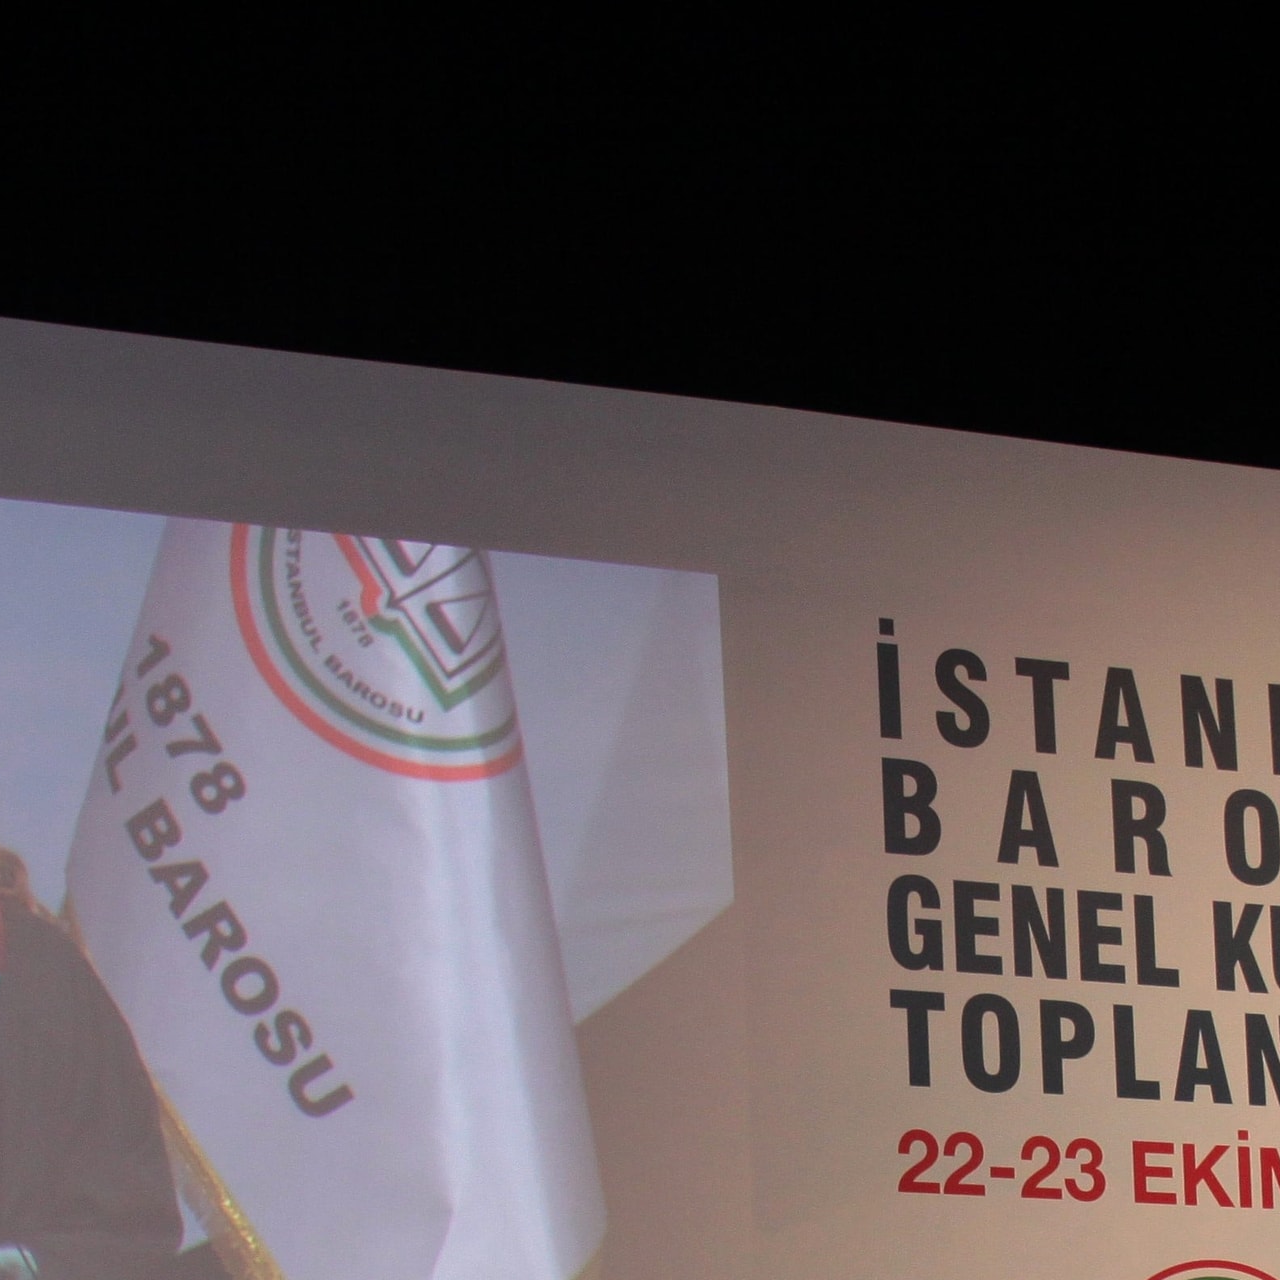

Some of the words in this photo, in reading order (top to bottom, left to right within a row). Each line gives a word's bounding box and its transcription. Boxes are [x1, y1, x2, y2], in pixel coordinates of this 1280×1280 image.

[335, 600, 375, 649] 1878
[136, 633, 248, 816] 1878
[323, 654, 426, 724] BAROSU
[124, 796, 356, 1119] BAROSU
[885, 873, 1181, 989] GENEL
[896, 1127, 1108, 1203] 22-23
